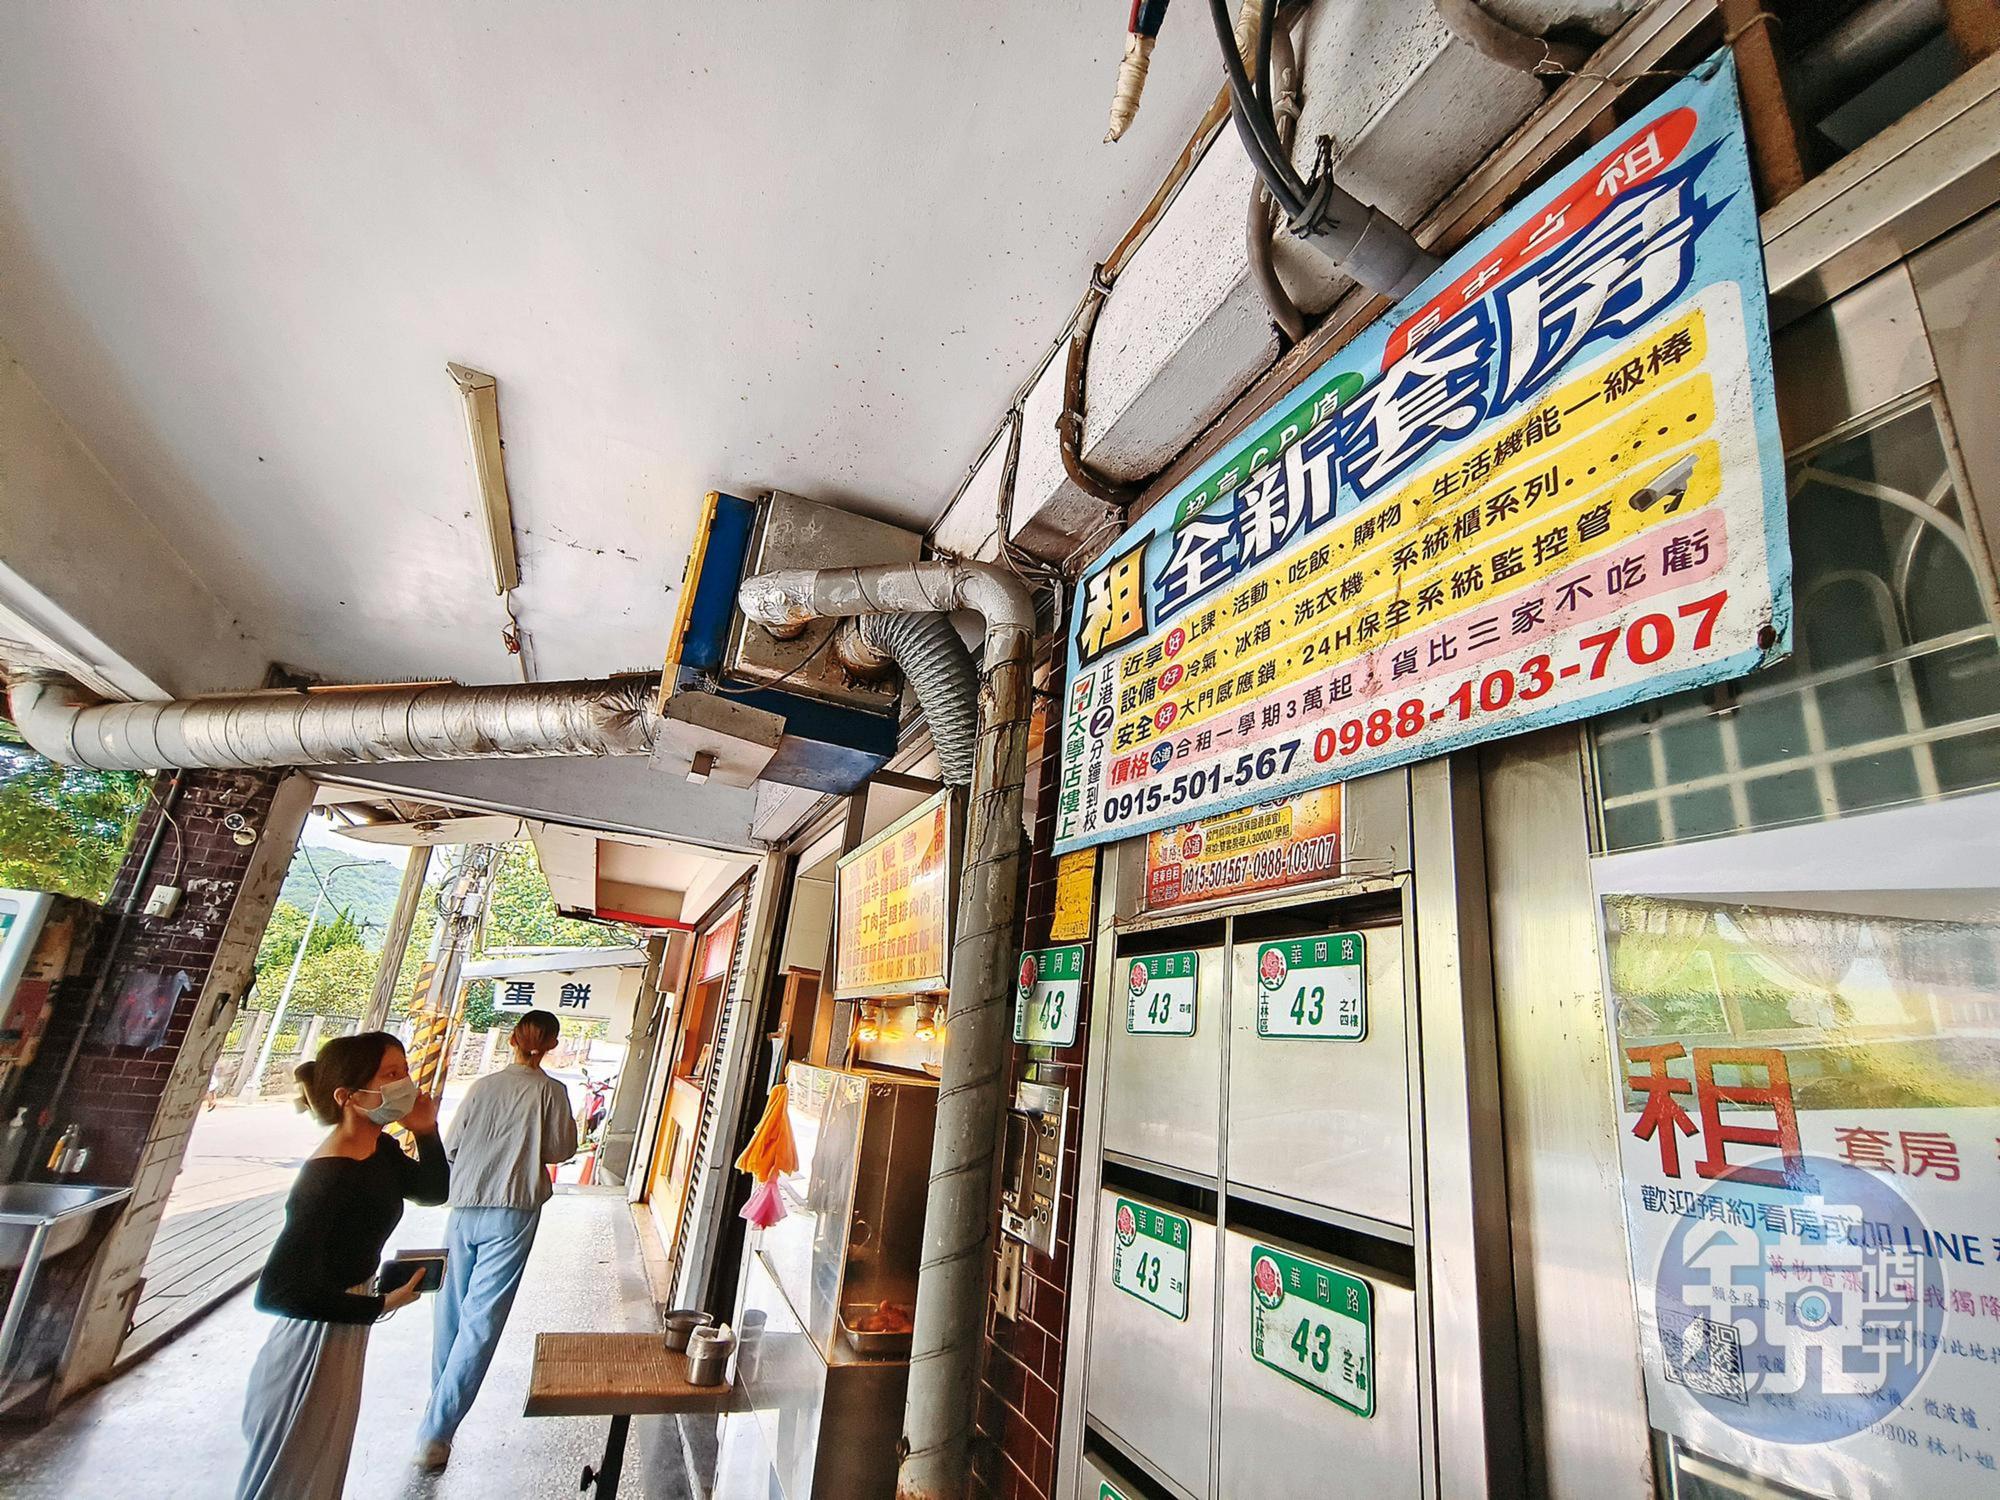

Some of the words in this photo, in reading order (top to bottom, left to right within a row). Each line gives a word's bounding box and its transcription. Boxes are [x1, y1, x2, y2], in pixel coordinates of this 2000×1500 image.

[1157, 176, 1698, 622] 全新套房
[1076, 532, 1155, 666] 租
[1103, 739, 1302, 824] 0915-501-567
[1313, 589, 1731, 763] 0988-103-707
[502, 981, 591, 1009] 蛋餅
[1039, 990, 1065, 1030] 43
[1148, 993, 1171, 1024] 43
[1290, 986, 1325, 1025] 43
[1626, 1041, 1819, 1192] 租
[1834, 1126, 1960, 1182] 套房
[1903, 1225, 1985, 1266] LINE
[1136, 1251, 1161, 1293] 43
[1291, 1317, 1331, 1373] 43
